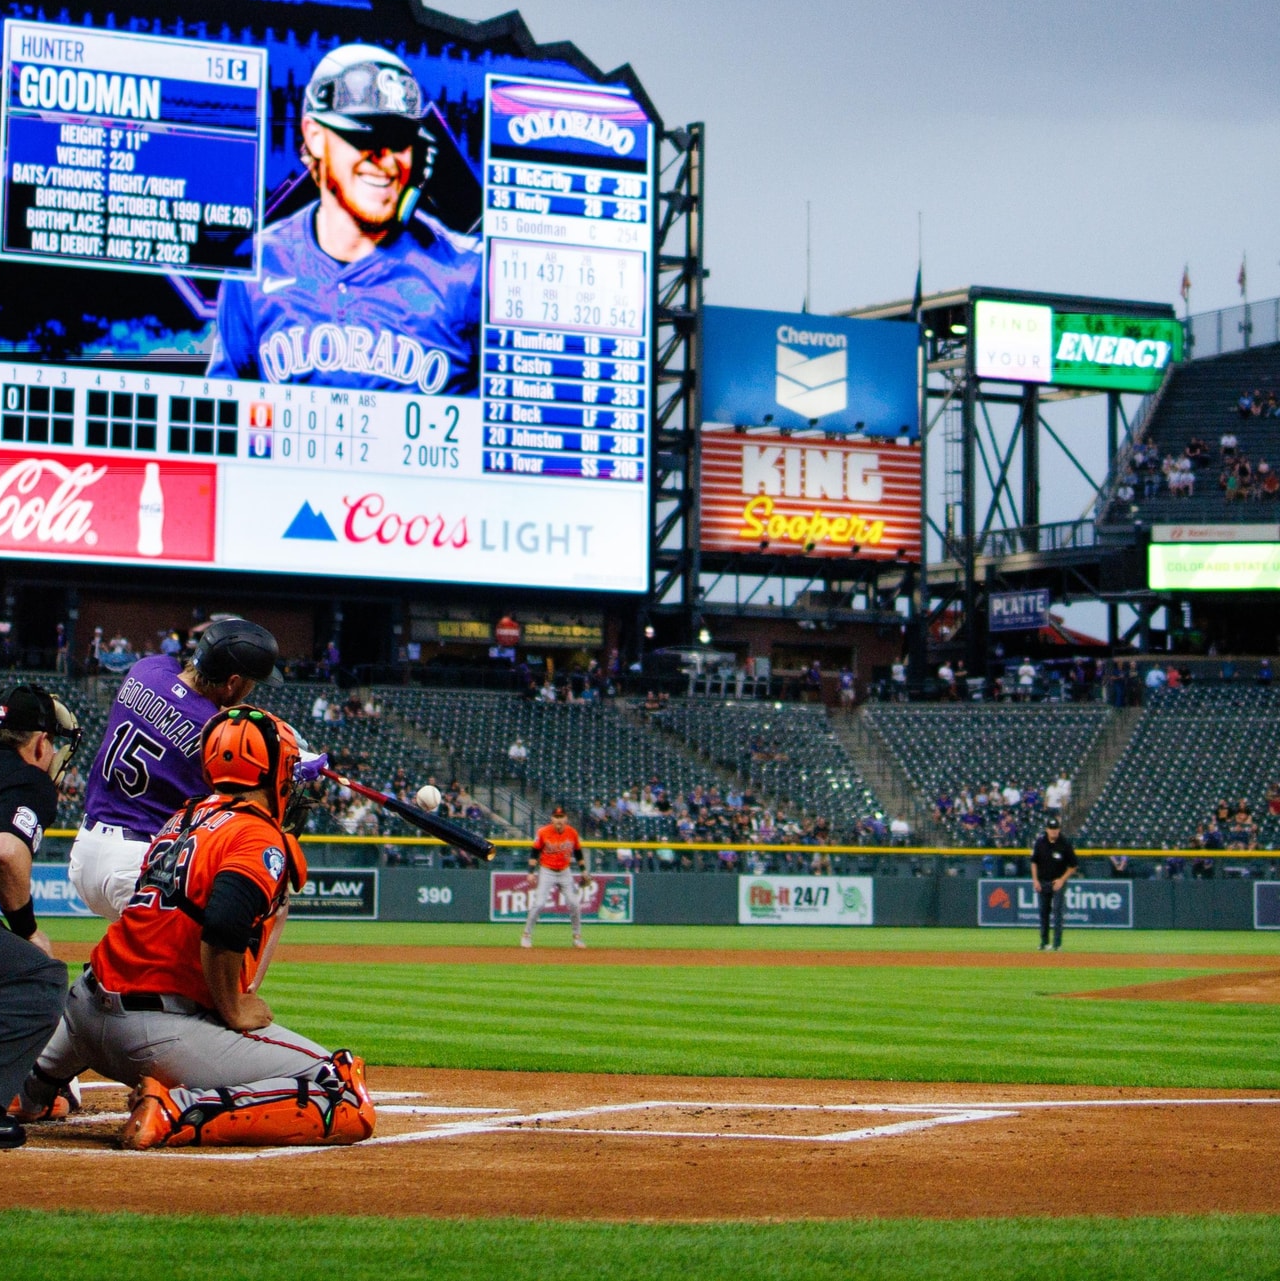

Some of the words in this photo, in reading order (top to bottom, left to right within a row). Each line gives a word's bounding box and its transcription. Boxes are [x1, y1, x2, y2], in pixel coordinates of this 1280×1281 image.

[21, 34, 85, 63] HUNTER
[206, 56, 224, 80] 15
[231, 59, 243, 81] C
[20, 66, 161, 120] GOODMAN
[61, 124, 107, 148] HEIGHT:
[508, 111, 636, 156] COLORADO
[57, 145, 107, 169] WEIGHT:
[109, 152, 135, 171] 220
[13, 163, 106, 190] BATS/THROWS:
[109, 173, 186, 198] RIGHT/RIGHT
[493, 165, 509, 183] 31
[516, 167, 571, 193] McCarthy
[36, 188, 105, 213] BIRTHDATE:
[108, 195, 158, 217] OCTOBER
[173, 200, 200, 221] 1999
[204, 204, 231, 226] (AGE
[232, 206, 252, 228] 26)
[26, 209, 104, 235] BIRTHPLACE:
[107, 216, 178, 242] ARLINGTON,
[180, 223, 198, 243] TN
[494, 215, 508, 232] 15
[516, 217, 567, 237] Goodman
[31, 231, 58, 252] MLB
[61, 234, 104, 256] DEBUT:
[107, 238, 132, 259] AUG
[135, 242, 153, 263] 27,
[156, 244, 189, 264] 2023
[503, 260, 527, 280] 111
[536, 263, 564, 283] 437
[579, 266, 595, 286] 16
[505, 299, 524, 319] 36
[541, 302, 559, 322] 73
[776, 324, 848, 349] Chevron
[990, 315, 1038, 333] FIND
[260, 323, 449, 395] COLORADO
[987, 351, 1041, 368] YOUR
[1056, 332, 1172, 369] ENERGY
[513, 355, 553, 376] Castro
[358, 393, 377, 408] ABS
[489, 377, 507, 397] 22
[512, 379, 555, 400] Moniak
[489, 402, 507, 421] 27
[511, 403, 542, 424] Beck
[489, 427, 507, 446] 20
[511, 428, 563, 450] Johnston
[402, 444, 412, 466] 2
[418, 445, 460, 469] OUTS
[489, 452, 506, 470] 14
[511, 453, 544, 473] Tovar
[742, 444, 884, 502] KING
[342, 492, 471, 550] Coors
[480, 520, 595, 557] LIGHT
[739, 496, 886, 553] Soopers
[992, 594, 1045, 617] PLATTE
[117, 677, 203, 759] GOODMAN
[102, 720, 167, 799] 15
[319, 881, 364, 896] LAW
[417, 887, 453, 904] 390
[793, 886, 830, 907] 24/7
[1018, 886, 1123, 910] Litime
